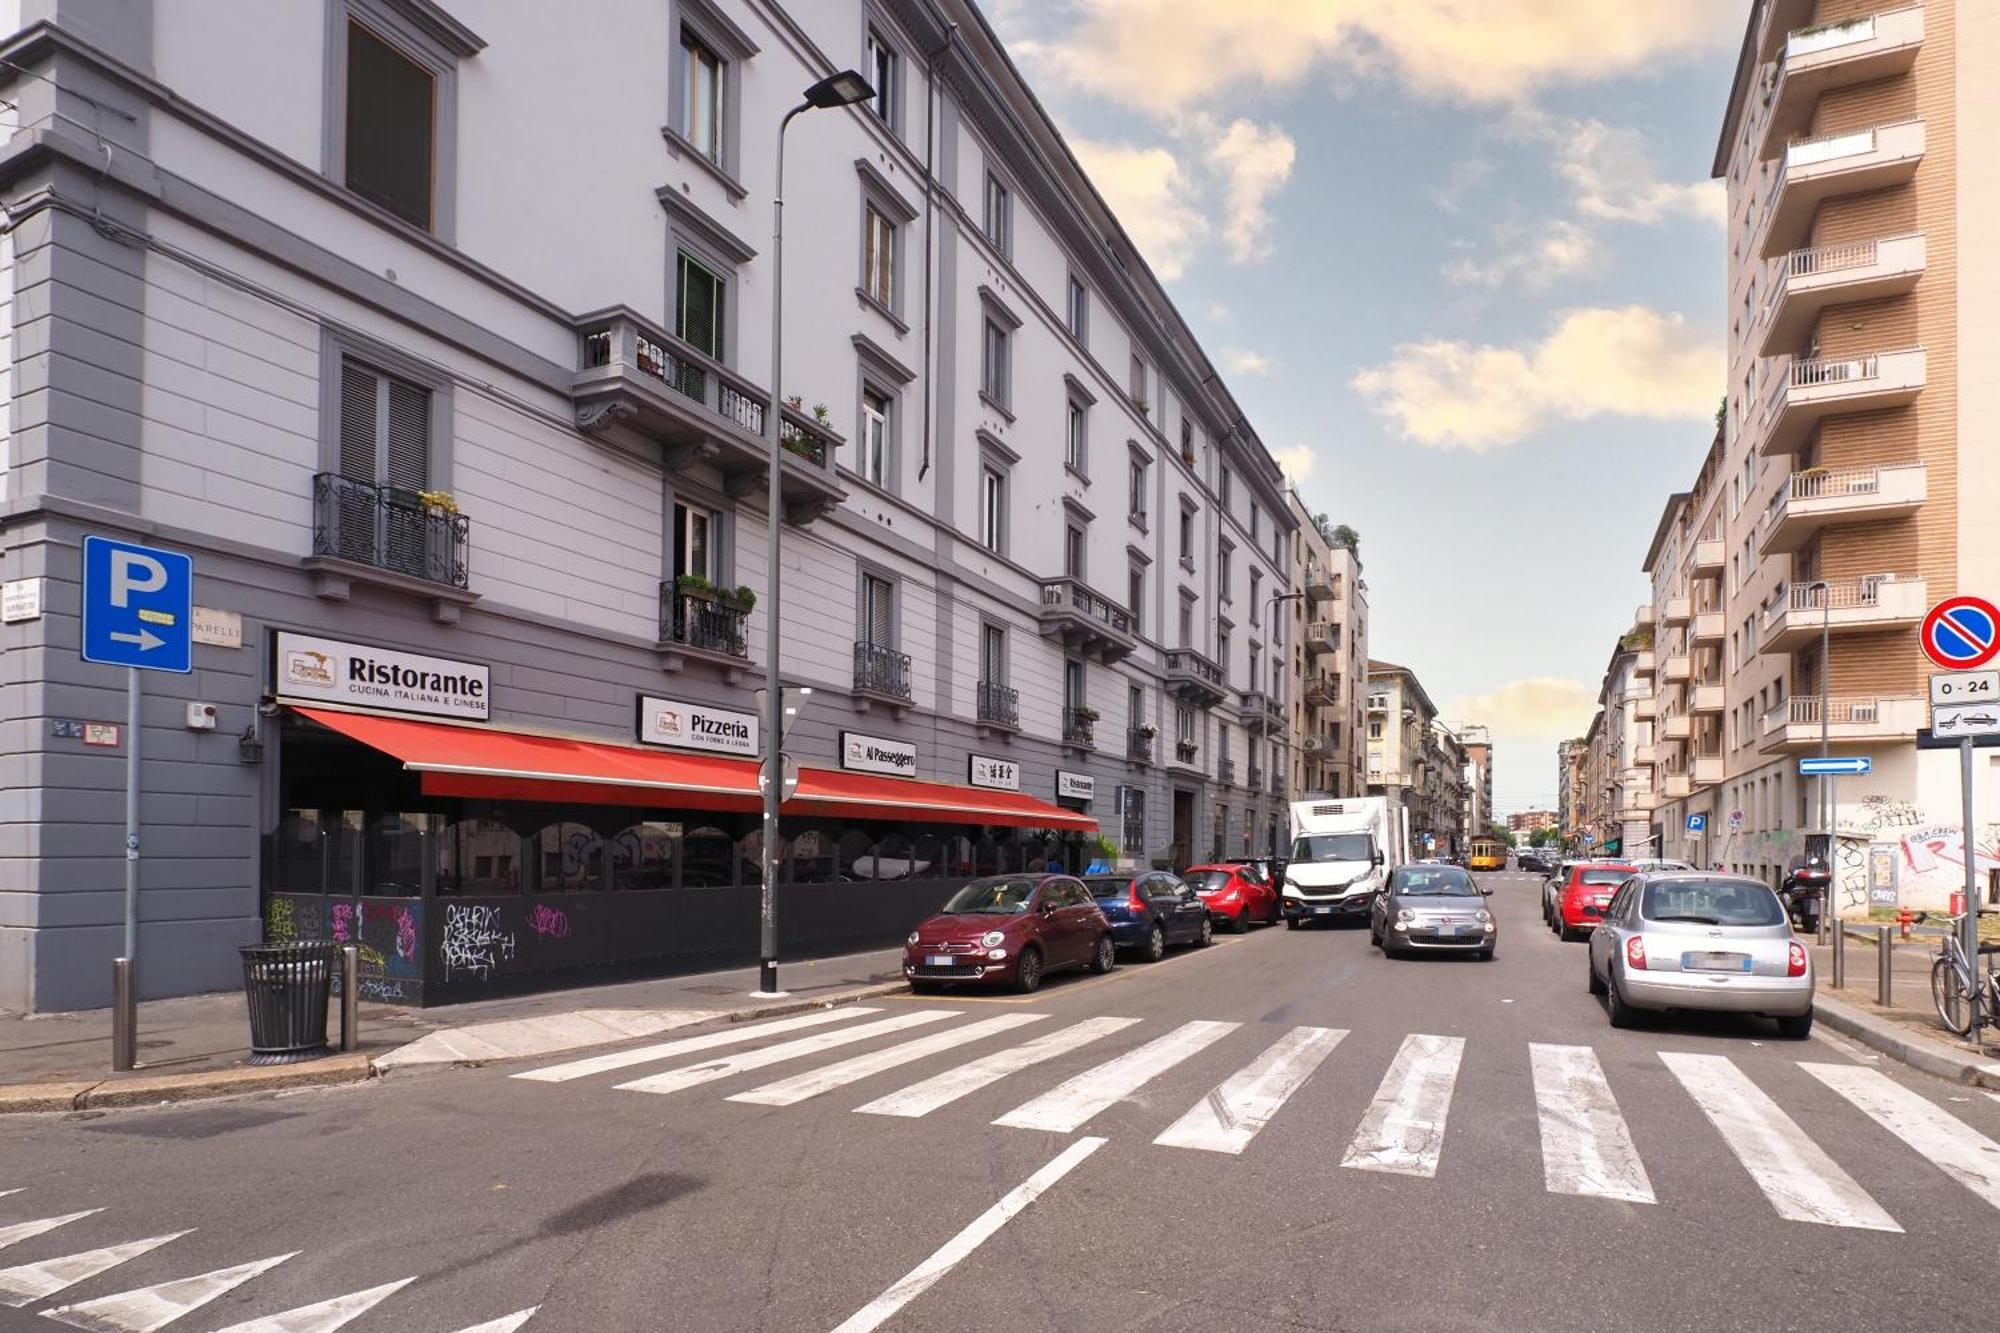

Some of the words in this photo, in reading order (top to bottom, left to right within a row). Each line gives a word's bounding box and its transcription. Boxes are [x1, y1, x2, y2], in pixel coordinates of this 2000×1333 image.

[110, 549, 168, 608] P
[349, 657, 484, 697] Ristorante
[1942, 683, 1952, 695] 0
[1968, 680, 1989, 692] 24
[349, 684, 390, 697] CUCINA
[394, 689, 440, 704] ITALIANA
[444, 696, 450, 705] E
[454, 698, 487, 710] CINESE
[691, 714, 748, 739] Pizzeria
[691, 734, 705, 742] CON
[706, 736, 724, 745] FORNO
[866, 746, 873, 760] Al
[874, 747, 915, 768] Passeggero
[1690, 816, 1701, 830] P
